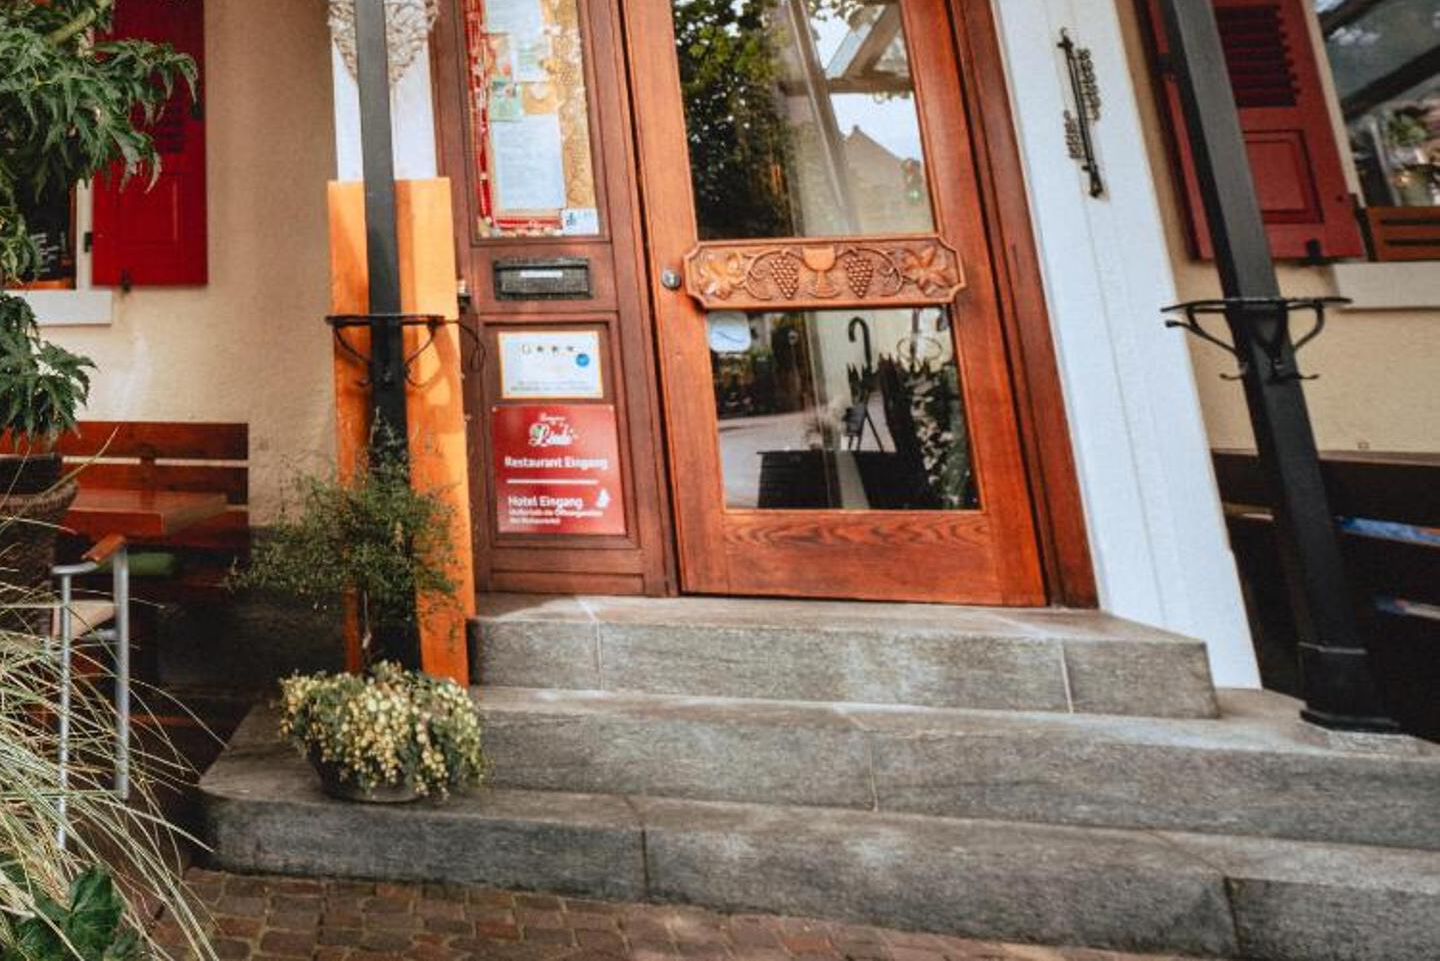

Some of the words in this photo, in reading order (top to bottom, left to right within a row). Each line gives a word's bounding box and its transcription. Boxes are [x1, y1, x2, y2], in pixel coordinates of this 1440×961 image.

[504, 456, 562, 468] Restaurant
[508, 496, 537, 507] Hotel
[540, 496, 583, 510] Eingang
